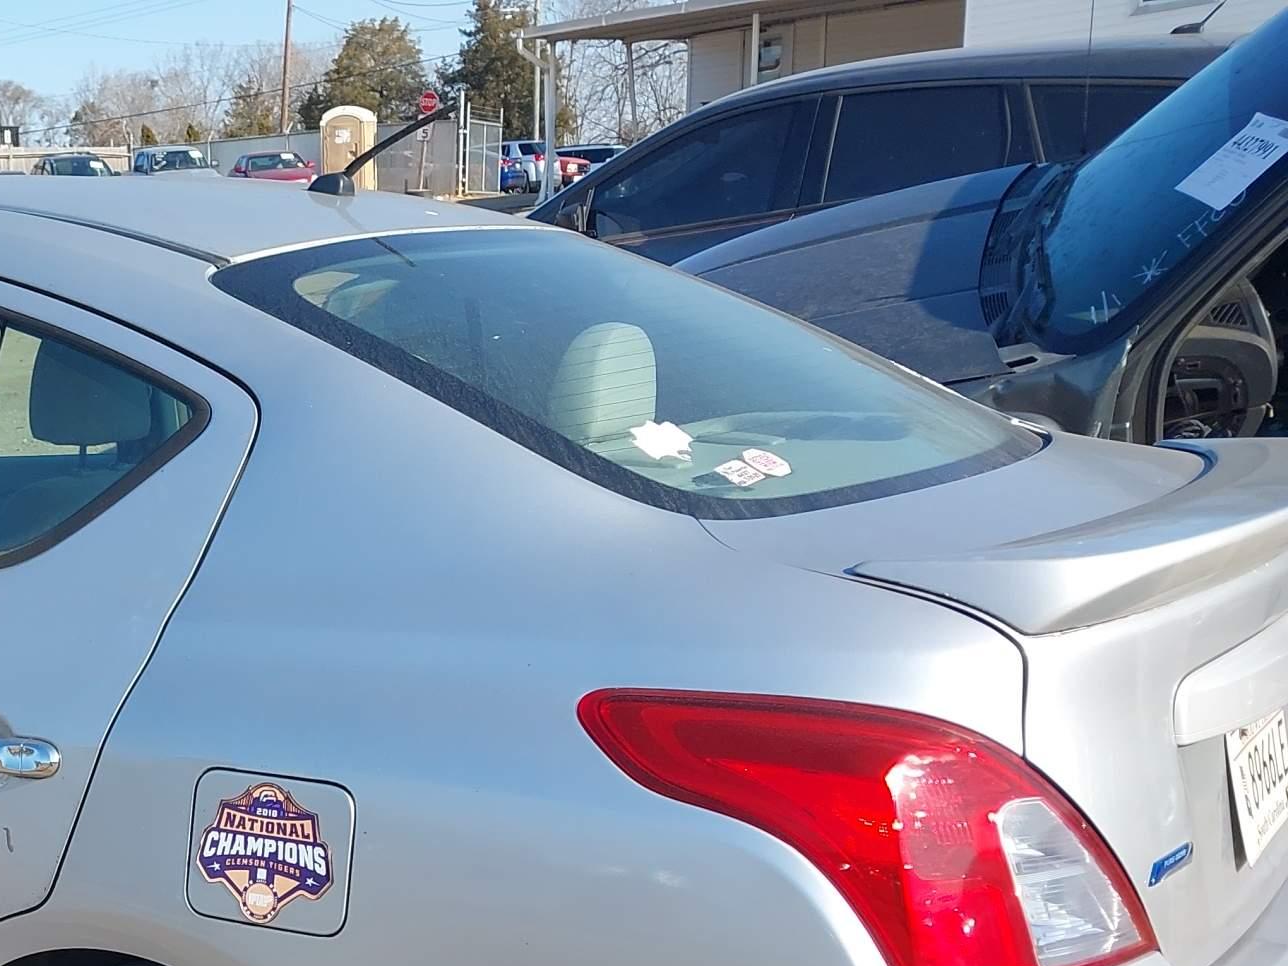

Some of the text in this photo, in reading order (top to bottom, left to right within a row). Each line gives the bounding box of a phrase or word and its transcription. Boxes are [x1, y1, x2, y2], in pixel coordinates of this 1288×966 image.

[421, 97, 437, 107] STOP
[421, 128, 429, 139] 5
[224, 811, 311, 840] NATIONAL
[203, 831, 327, 876] CHAMPIONS
[225, 857, 301, 877] CLEMSON TIGERS
